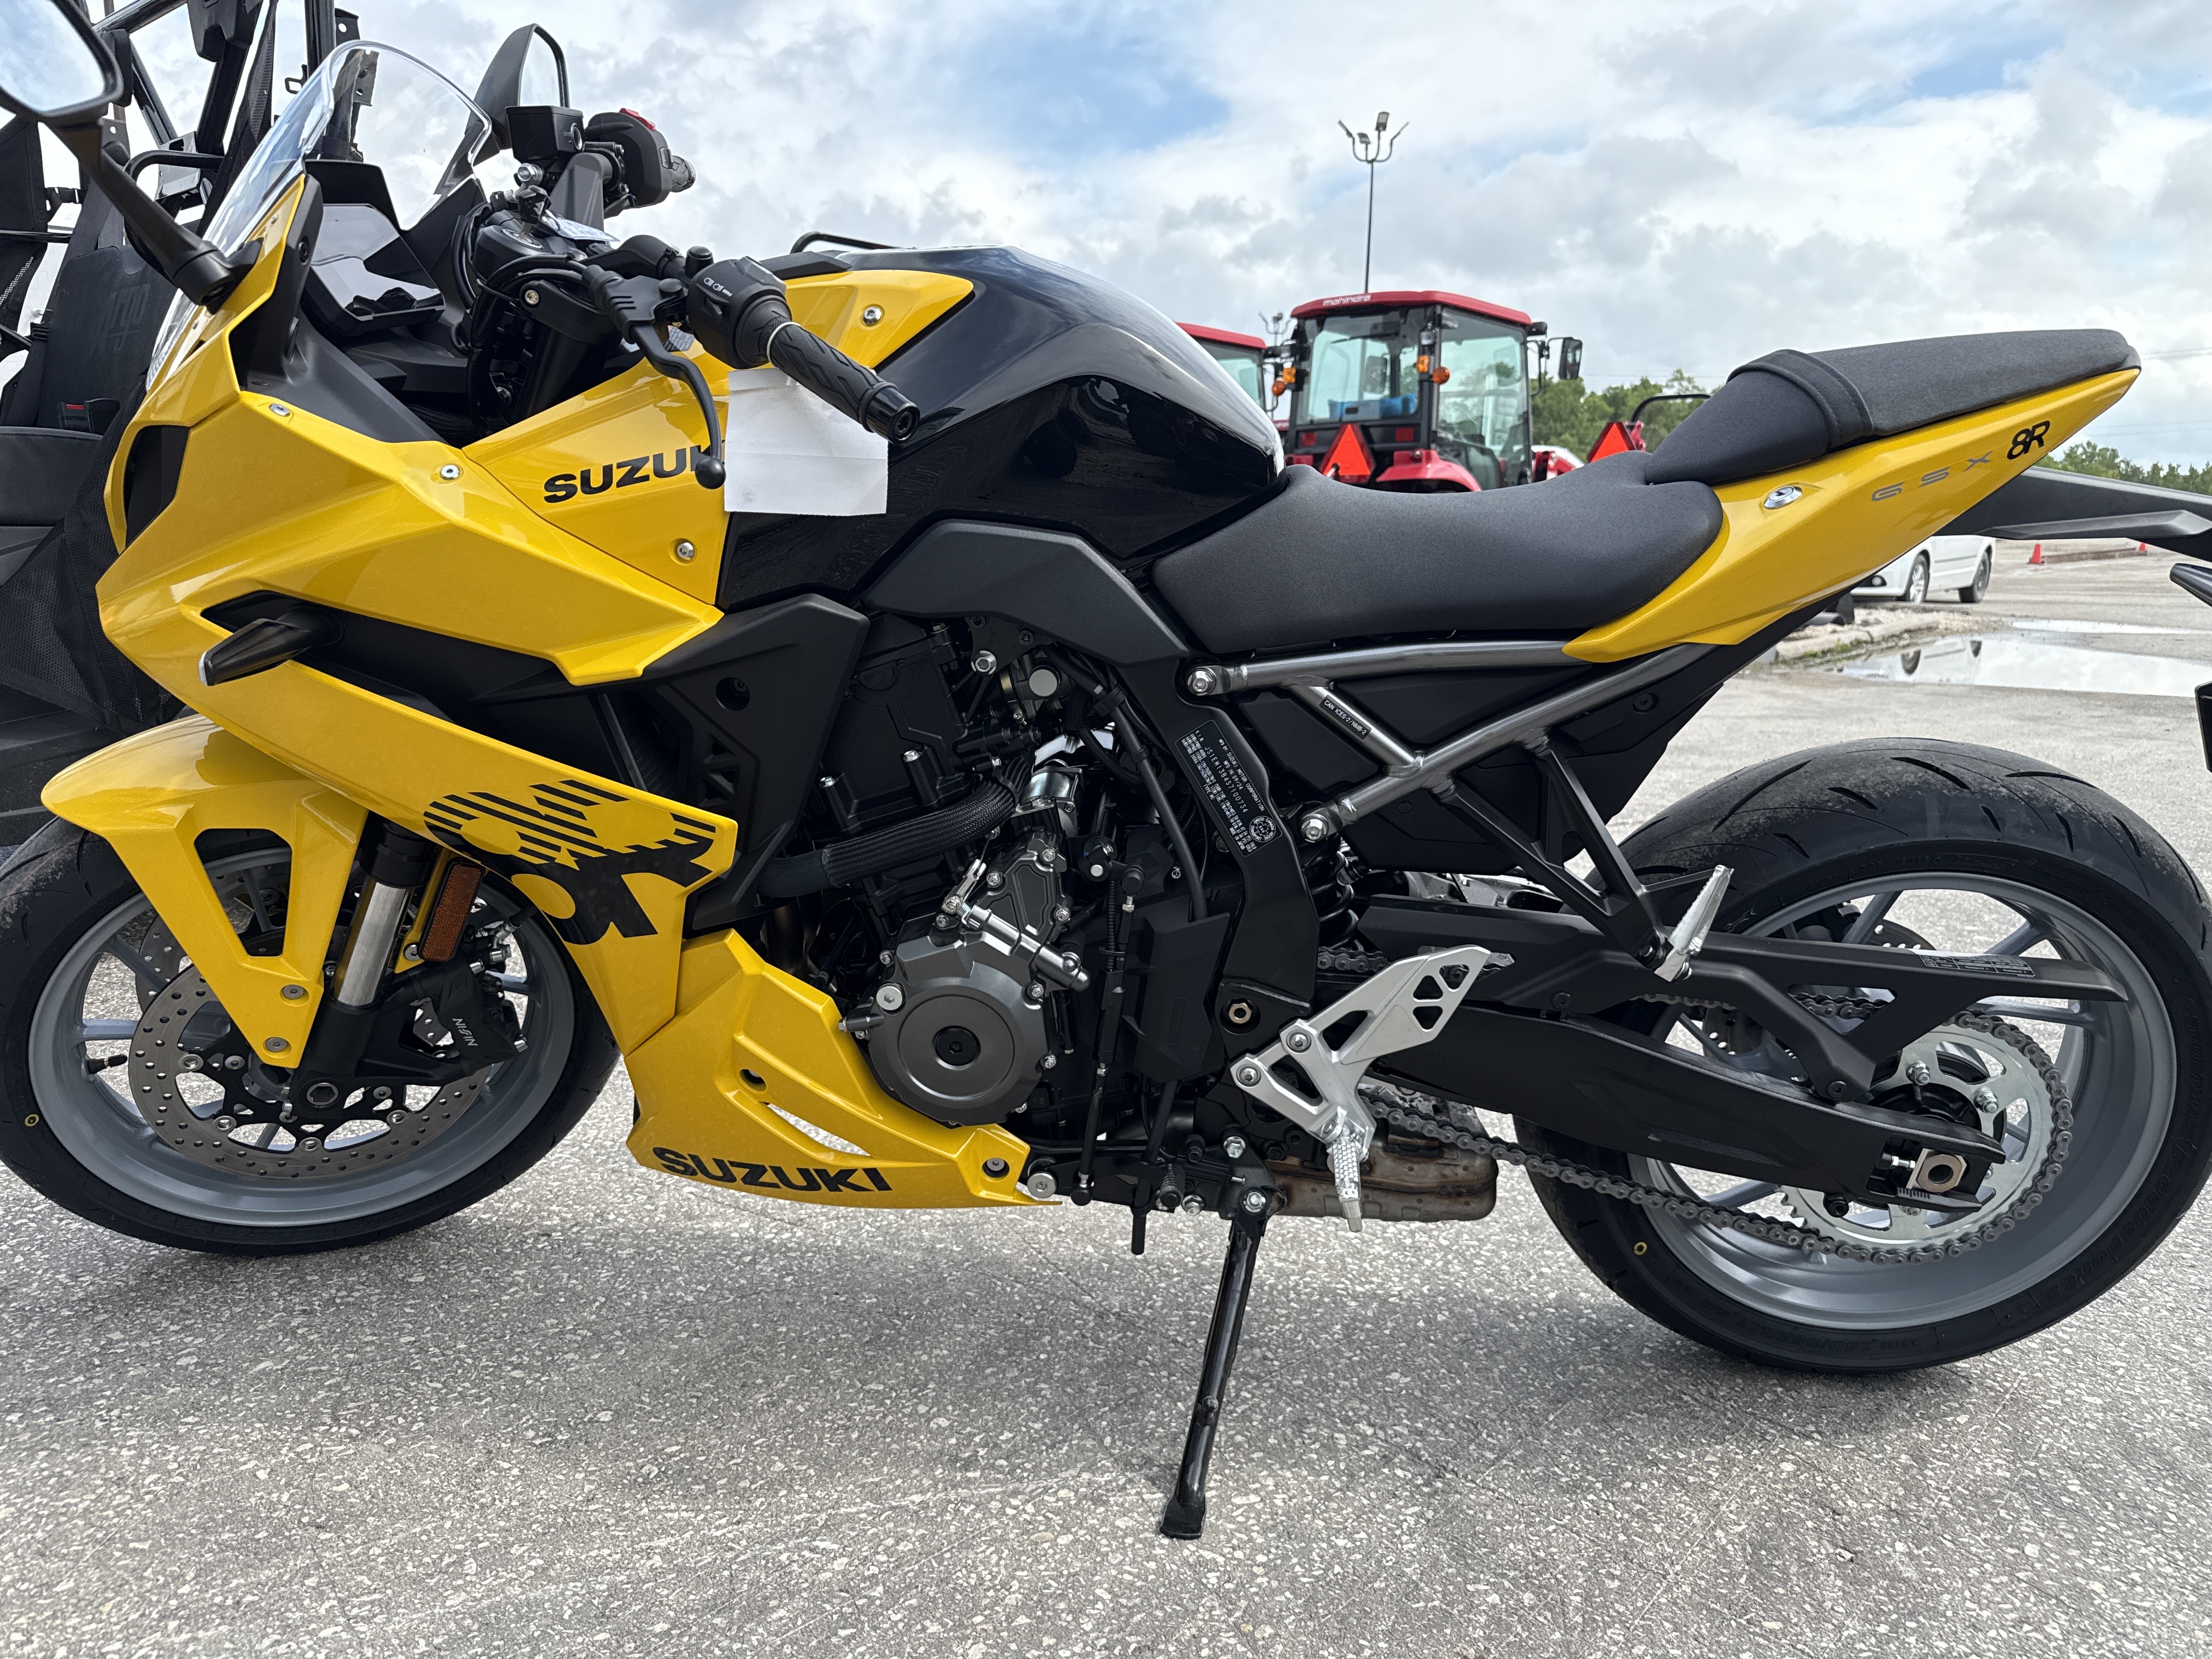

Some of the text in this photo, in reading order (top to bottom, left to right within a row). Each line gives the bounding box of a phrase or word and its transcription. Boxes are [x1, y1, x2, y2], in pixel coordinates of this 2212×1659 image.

[1322, 294, 1372, 306] mahindra
[2006, 420, 2050, 460] 8R
[543, 441, 725, 504] SUZU
[1323, 699, 1335, 710] CAN
[1203, 744, 1249, 813] JS1EM13B4S7100734
[1235, 768, 1248, 783] MOTOR
[1244, 782, 1266, 812] CORPORATION
[452, 1018, 479, 1046] NISSIN
[652, 1146, 893, 1193] SUZUKI
